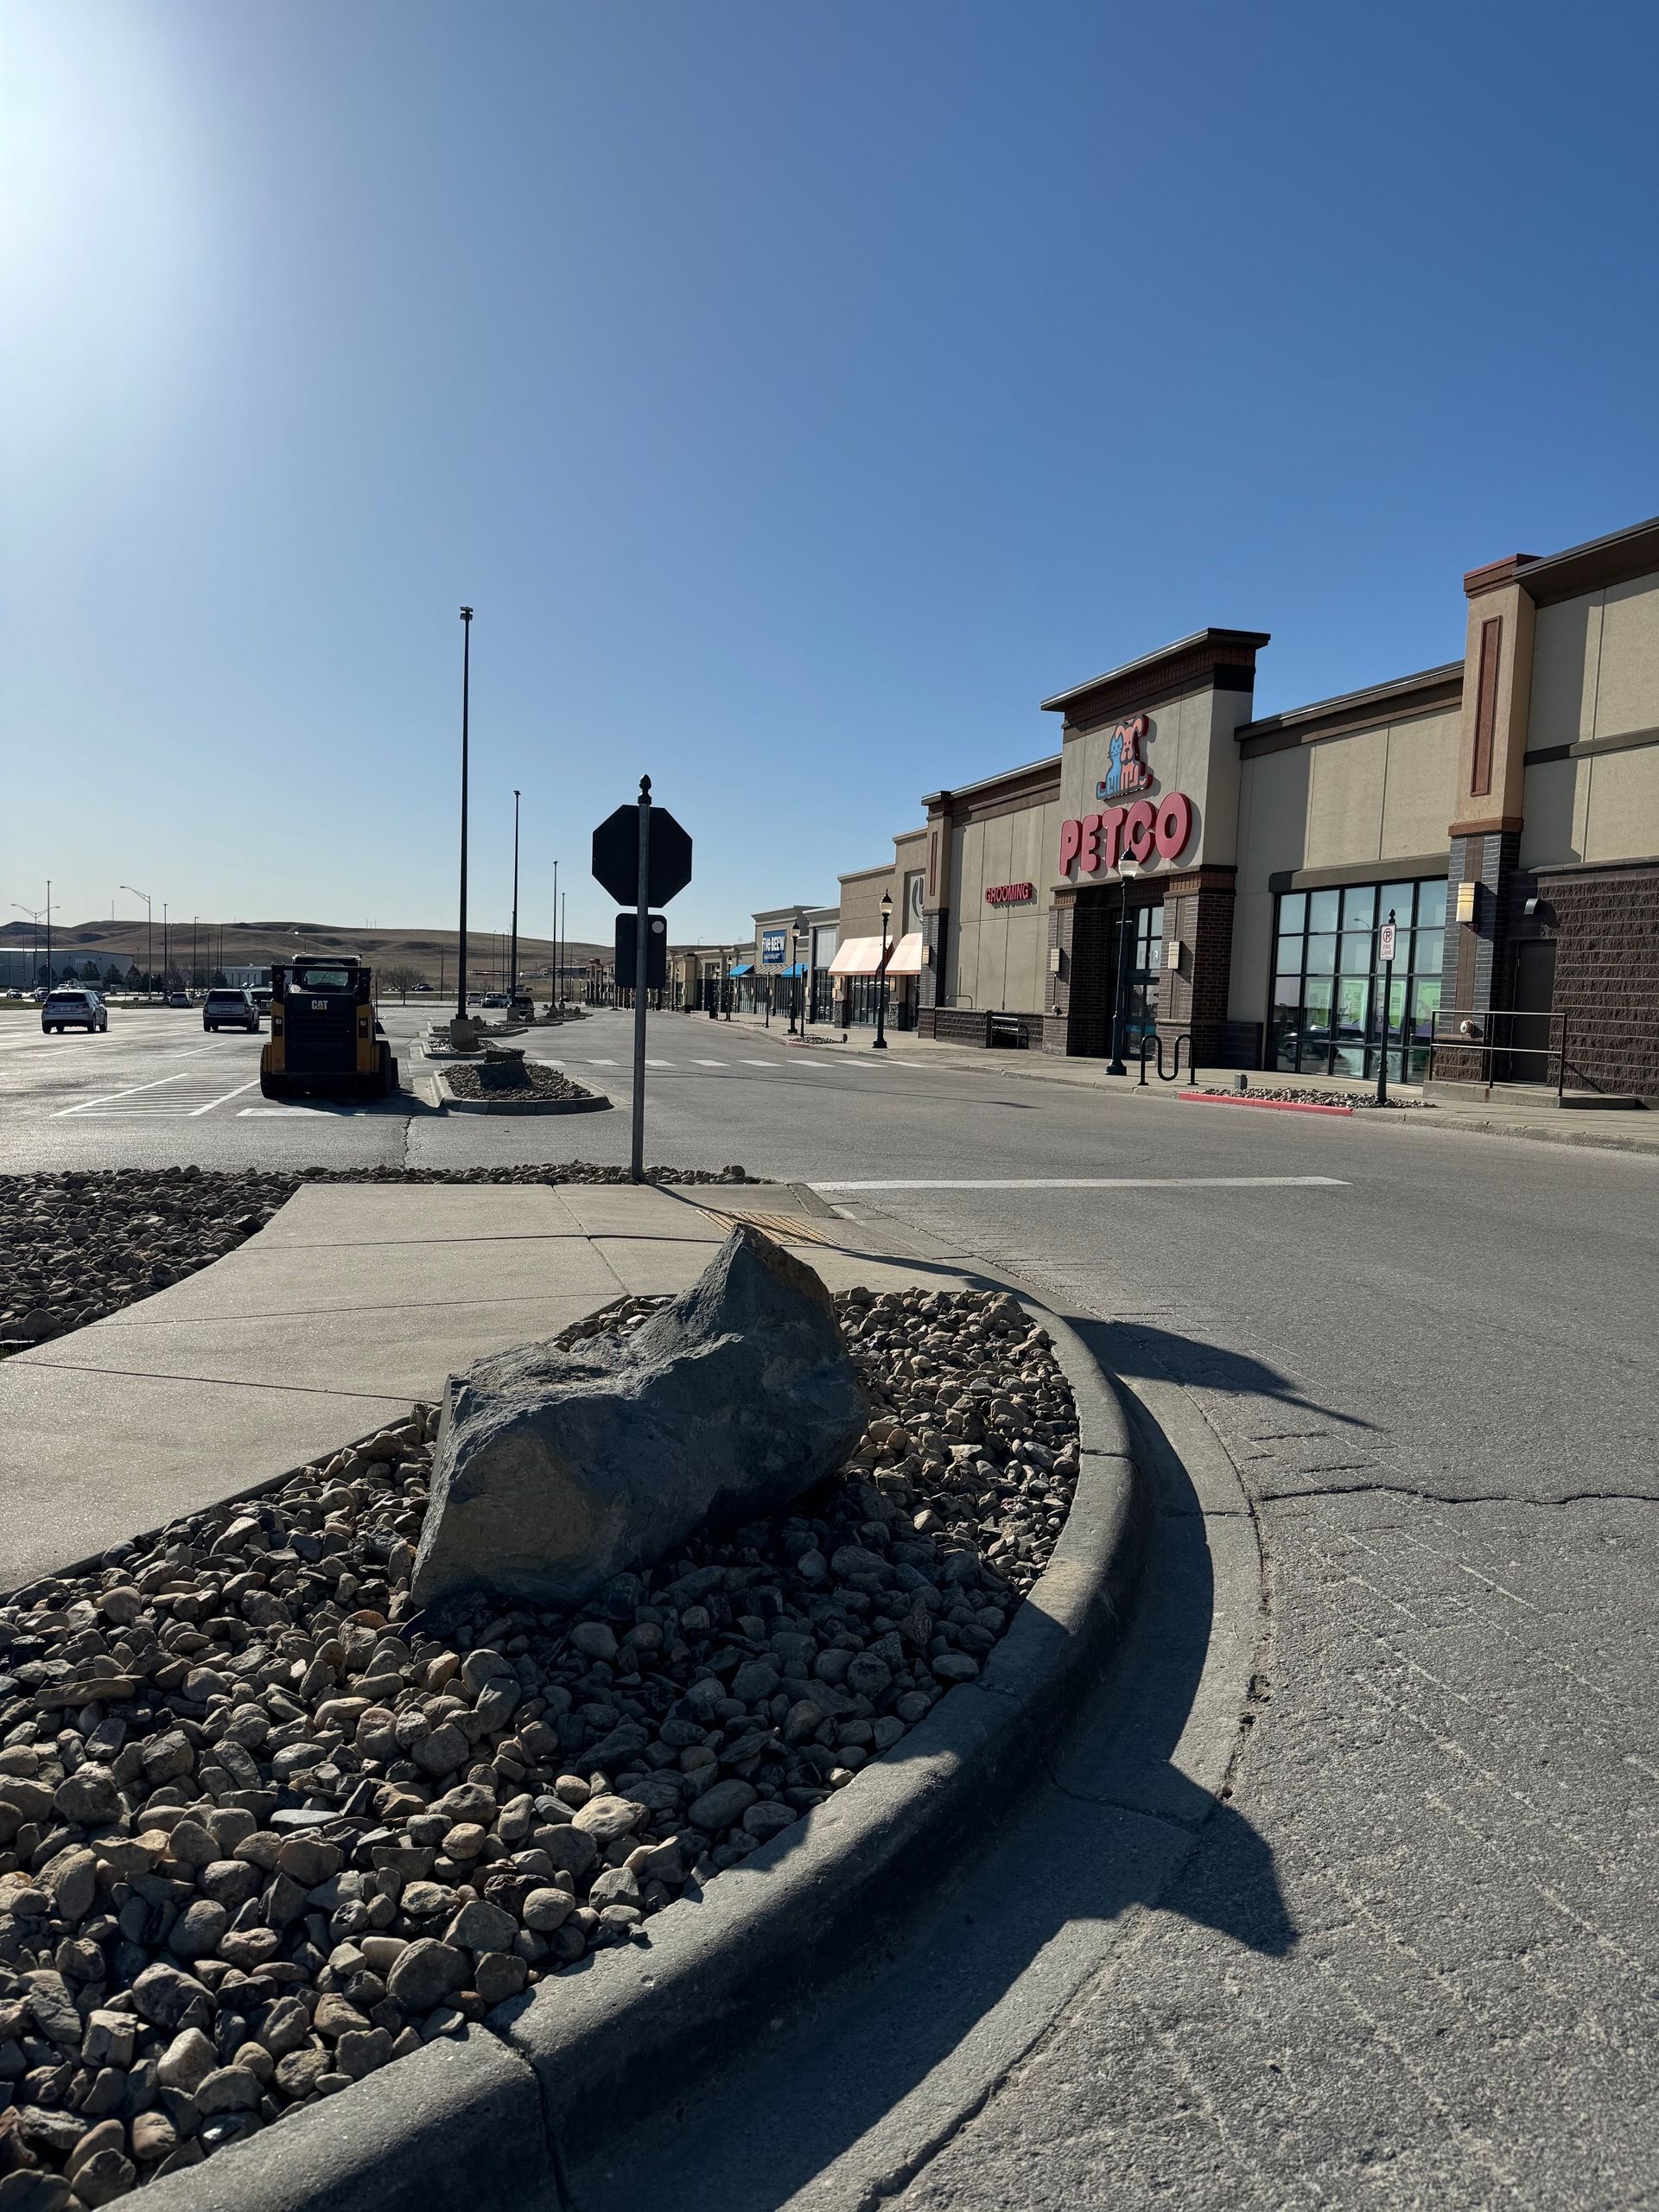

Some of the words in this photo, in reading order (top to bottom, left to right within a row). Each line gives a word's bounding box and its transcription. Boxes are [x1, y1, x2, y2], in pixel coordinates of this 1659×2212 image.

[1059, 791, 1192, 876] PETCO
[985, 882, 1031, 904] GROOMING
[311, 1000, 328, 1010] CAT
